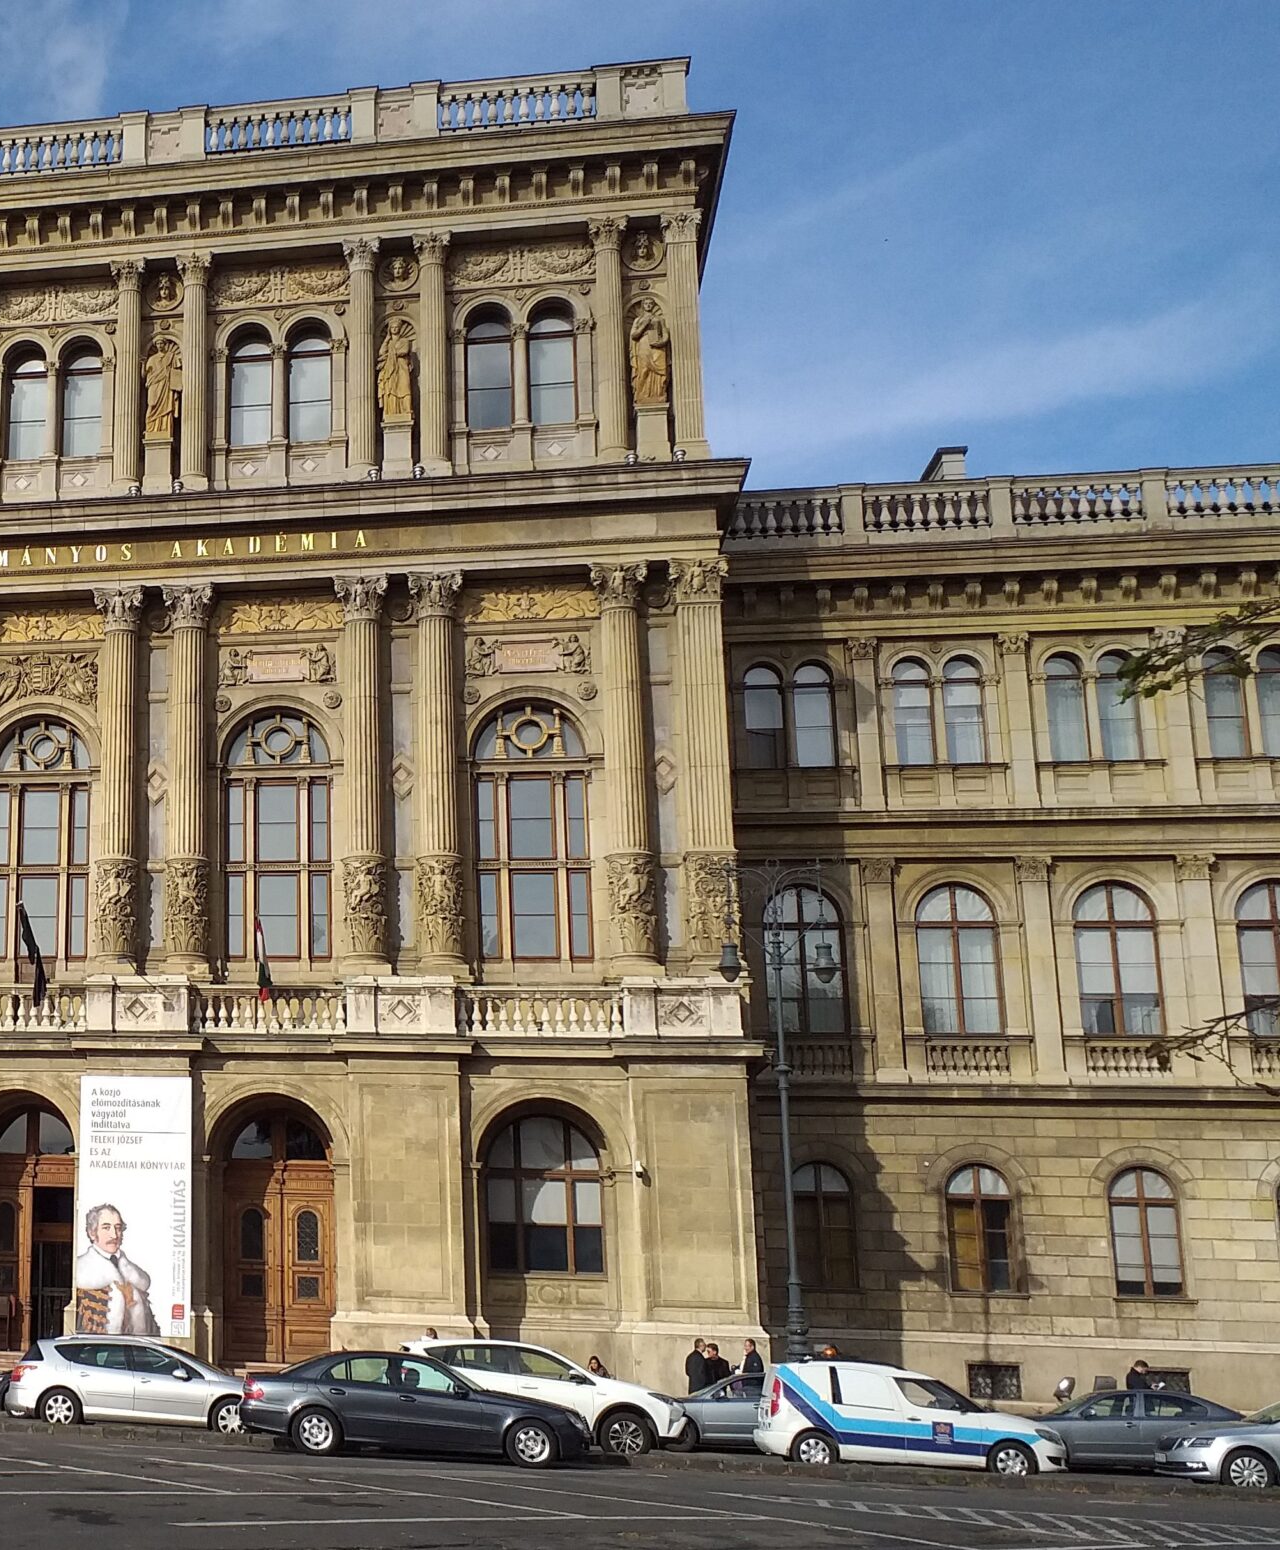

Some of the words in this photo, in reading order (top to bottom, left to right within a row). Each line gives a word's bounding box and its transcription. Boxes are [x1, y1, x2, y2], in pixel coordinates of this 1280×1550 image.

[170, 530, 367, 558] AKADÉMIA
[91, 1088, 98, 1096] A
[90, 1135, 115, 1144] TELEKI
[117, 1134, 144, 1146] JÓZSEF
[101, 1147, 112, 1156] AZ
[170, 1180, 186, 1248] KIÁLLÍTÁS
